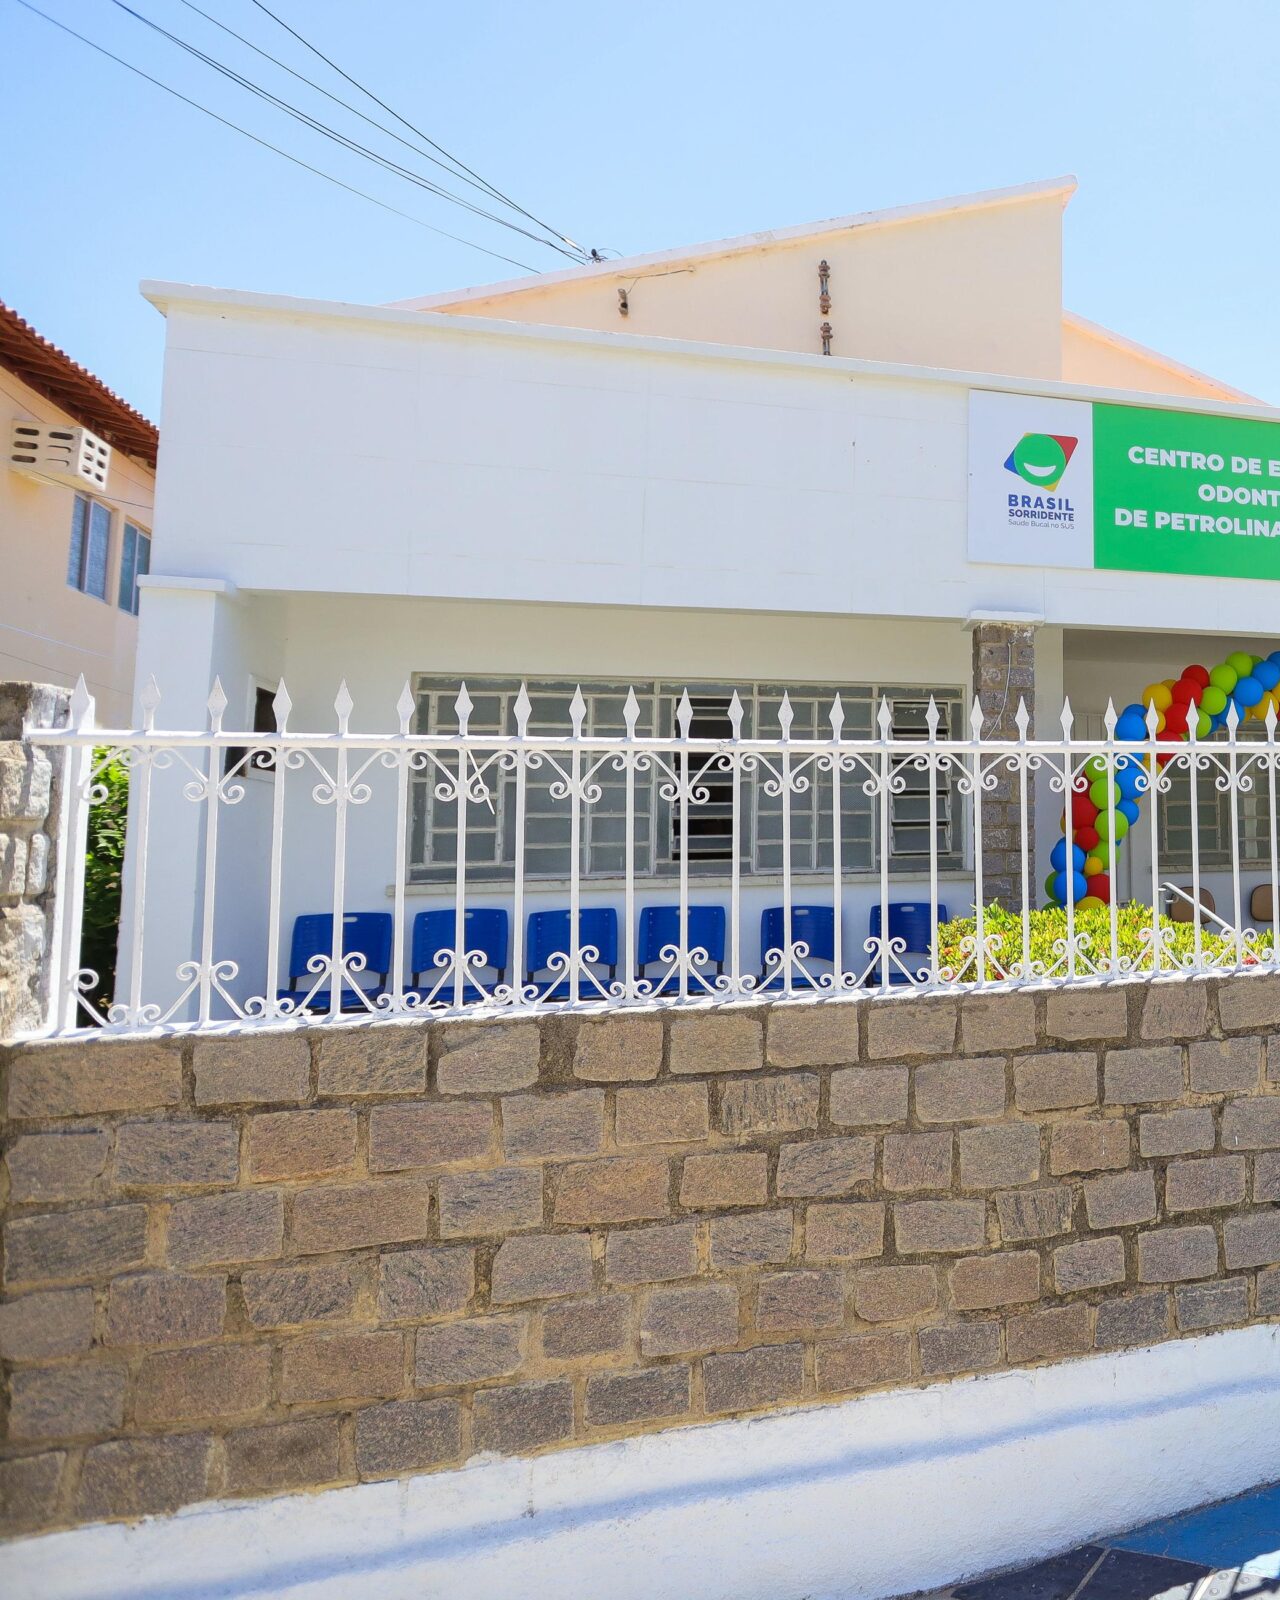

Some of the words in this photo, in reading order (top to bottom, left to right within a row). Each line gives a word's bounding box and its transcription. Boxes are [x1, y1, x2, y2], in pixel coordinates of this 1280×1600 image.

[1128, 446, 1225, 472] CENTRO
[1231, 456, 1262, 475] DE
[1008, 494, 1074, 512] BRASIL
[1008, 508, 1074, 522] SORRIDENTE
[1115, 508, 1147, 528] DE
[1031, 520, 1049, 528] Bucal
[1060, 522, 1075, 530] SUS
